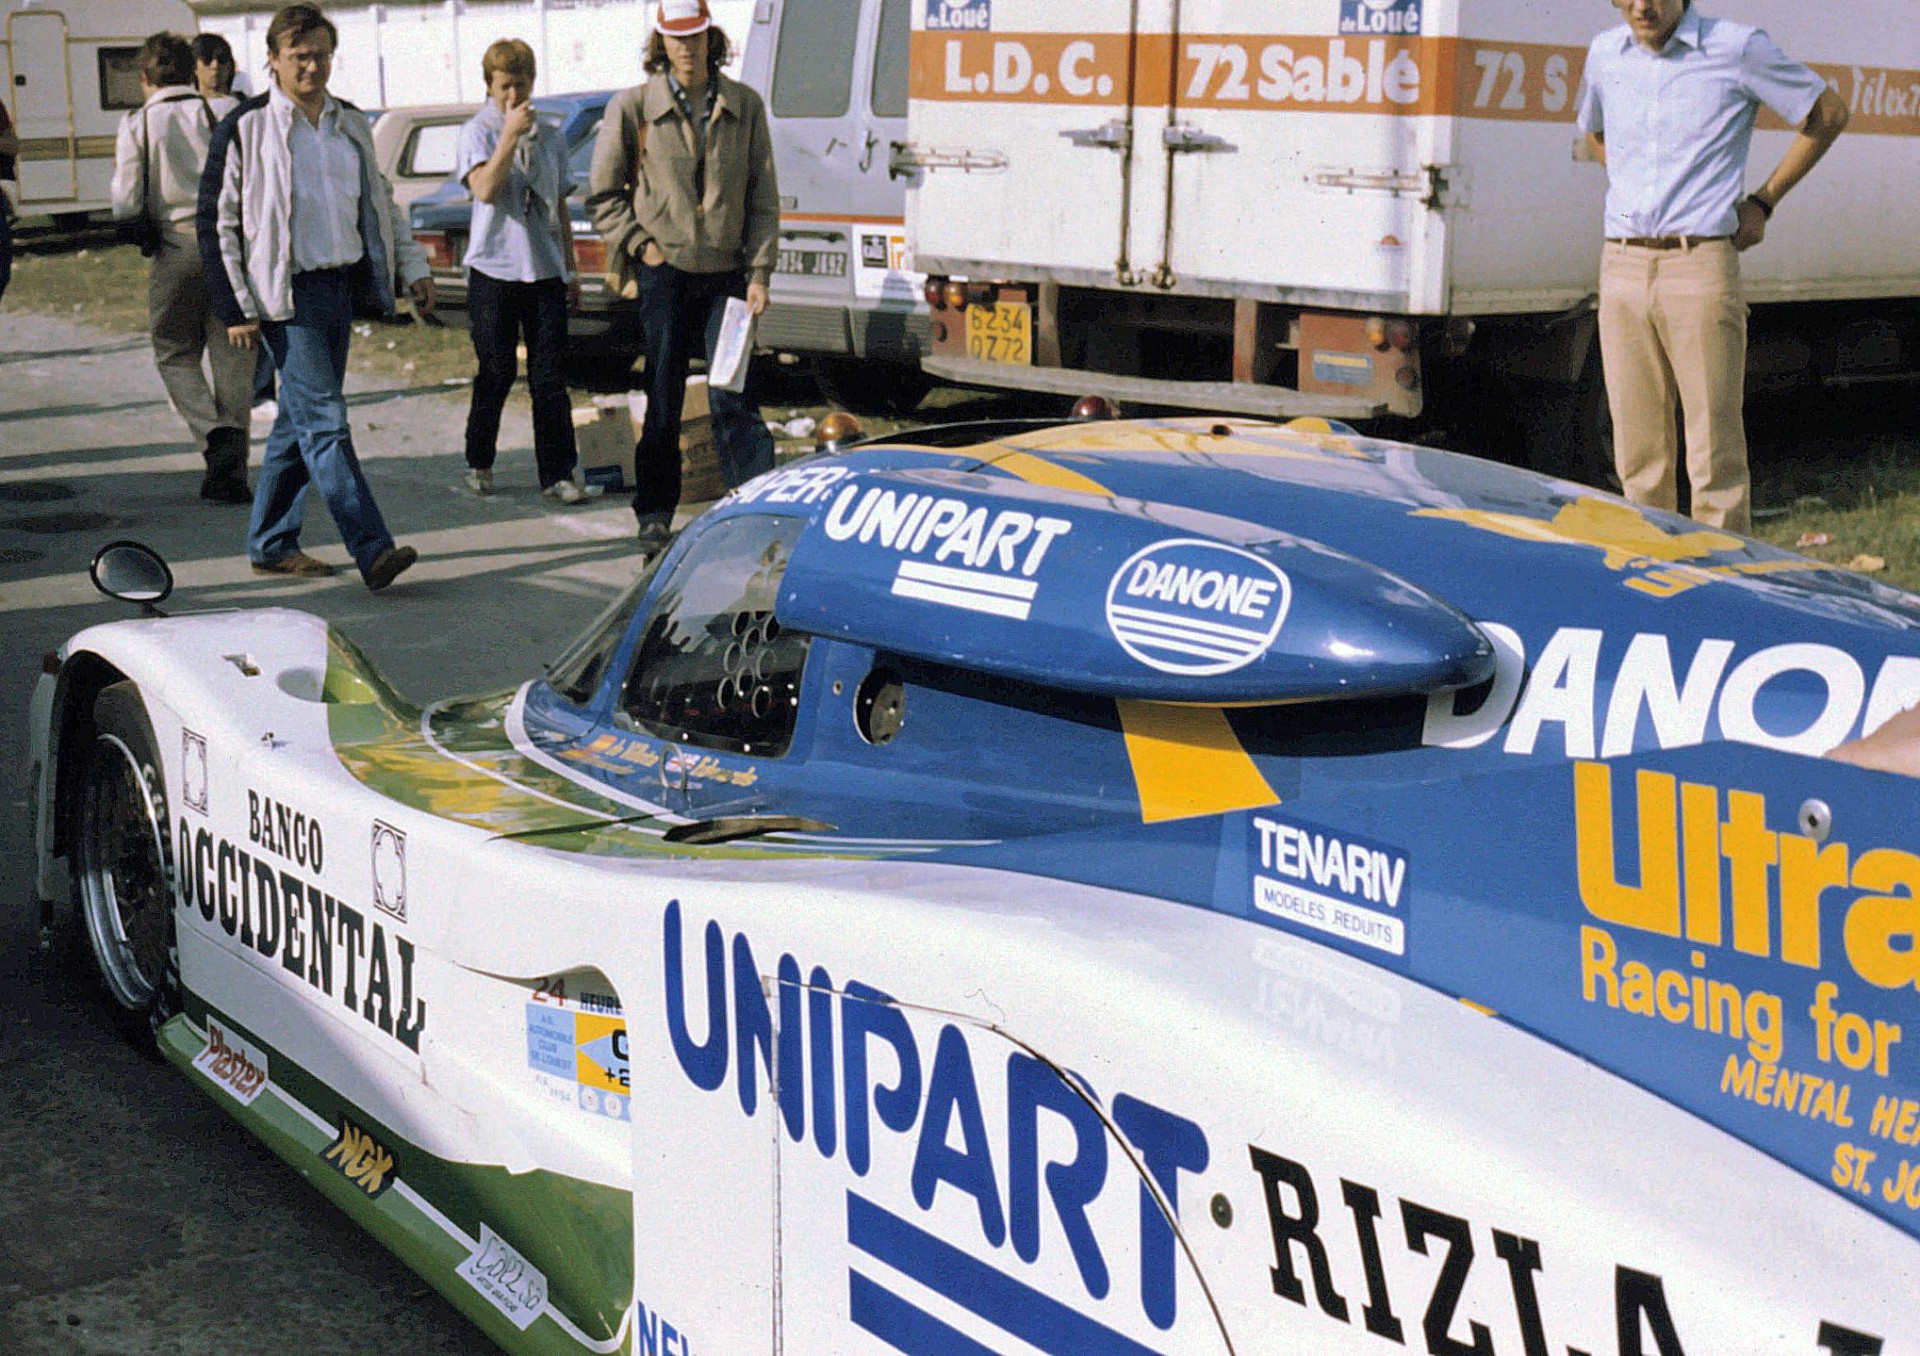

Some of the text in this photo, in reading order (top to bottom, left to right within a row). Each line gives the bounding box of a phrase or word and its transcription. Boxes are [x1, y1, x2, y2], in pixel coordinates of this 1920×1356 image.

[940, 3, 989, 29] Loué
[1357, 2, 1419, 33] Loué
[945, 40, 1114, 97] L.D.C.
[1186, 39, 1421, 104] 72 Sablé
[1474, 49, 1526, 109] 72
[825, 484, 1072, 577] UNIPART
[1126, 560, 1279, 620] DANONE
[248, 788, 323, 874] BANCO
[1253, 817, 1406, 908] TENARIV
[1573, 761, 1920, 989] Ultra
[180, 816, 426, 1056] OCCIDENTAL
[1263, 886, 1394, 944] MODELES REDUITS
[532, 976, 568, 1007] 24
[1581, 924, 1902, 1077] Racing for
[663, 899, 1210, 1332] UNIPART
[1720, 1053, 1854, 1128] MENTAL
[1831, 1142, 1877, 1195] ST.
